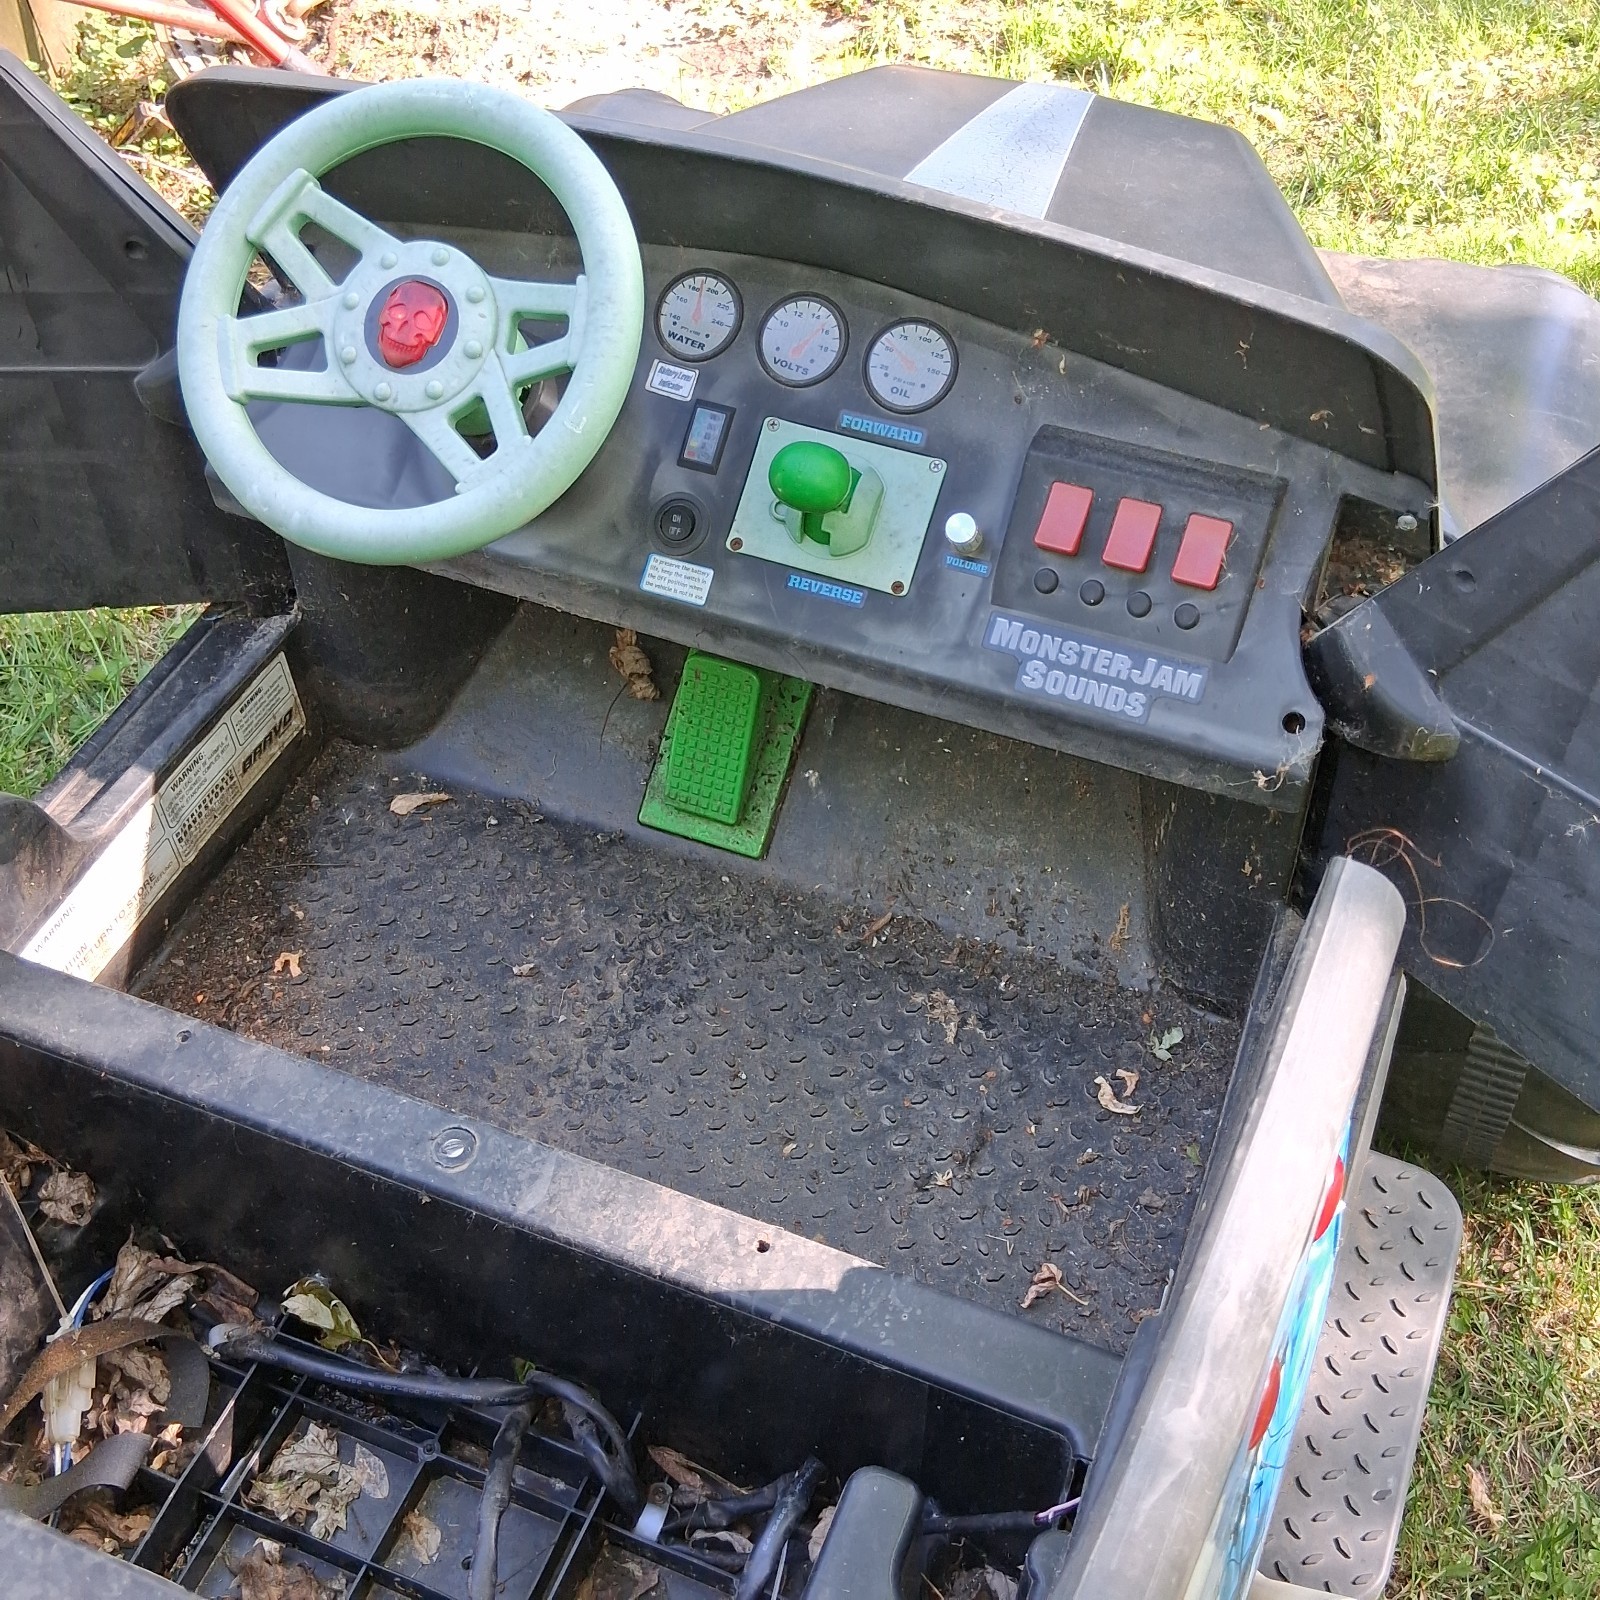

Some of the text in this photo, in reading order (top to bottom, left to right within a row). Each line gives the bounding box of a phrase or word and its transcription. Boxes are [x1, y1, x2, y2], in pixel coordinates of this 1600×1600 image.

[706, 287, 719, 295] 200
[676, 295, 688, 304] 160
[717, 302, 729, 311] 220
[669, 313, 680, 321] 140
[793, 310, 803, 318] 12
[711, 318, 724, 327] 240
[780, 320, 789, 328] 10
[821, 328, 830, 336] 16
[667, 330, 706, 351] WATER
[919, 335, 932, 344] 100
[884, 345, 894, 353] 50
[930, 351, 944, 360] 125
[773, 356, 809, 376] VOLTS
[927, 367, 941, 376] 150
[890, 386, 910, 399] OIL
[840, 414, 923, 445] FORWARD
[672, 514, 682, 523] ON
[945, 555, 988, 574] VOLUME
[787, 574, 863, 605] REVERSE
[1021, 659, 1147, 718] SOUNDS
[239, 687, 262, 713] WARNING:
[240, 707, 294, 773] BRAVO
[171, 750, 205, 792] WARNING:
[175, 784, 219, 837] DISTRIBUTED
[178, 811, 202, 843] BRAVO
[204, 774, 233, 810] SPORTS
[77, 925, 112, 969] RETURN
[127, 872, 155, 908] STORE
[451, 1393, 482, 1401] TUBING
